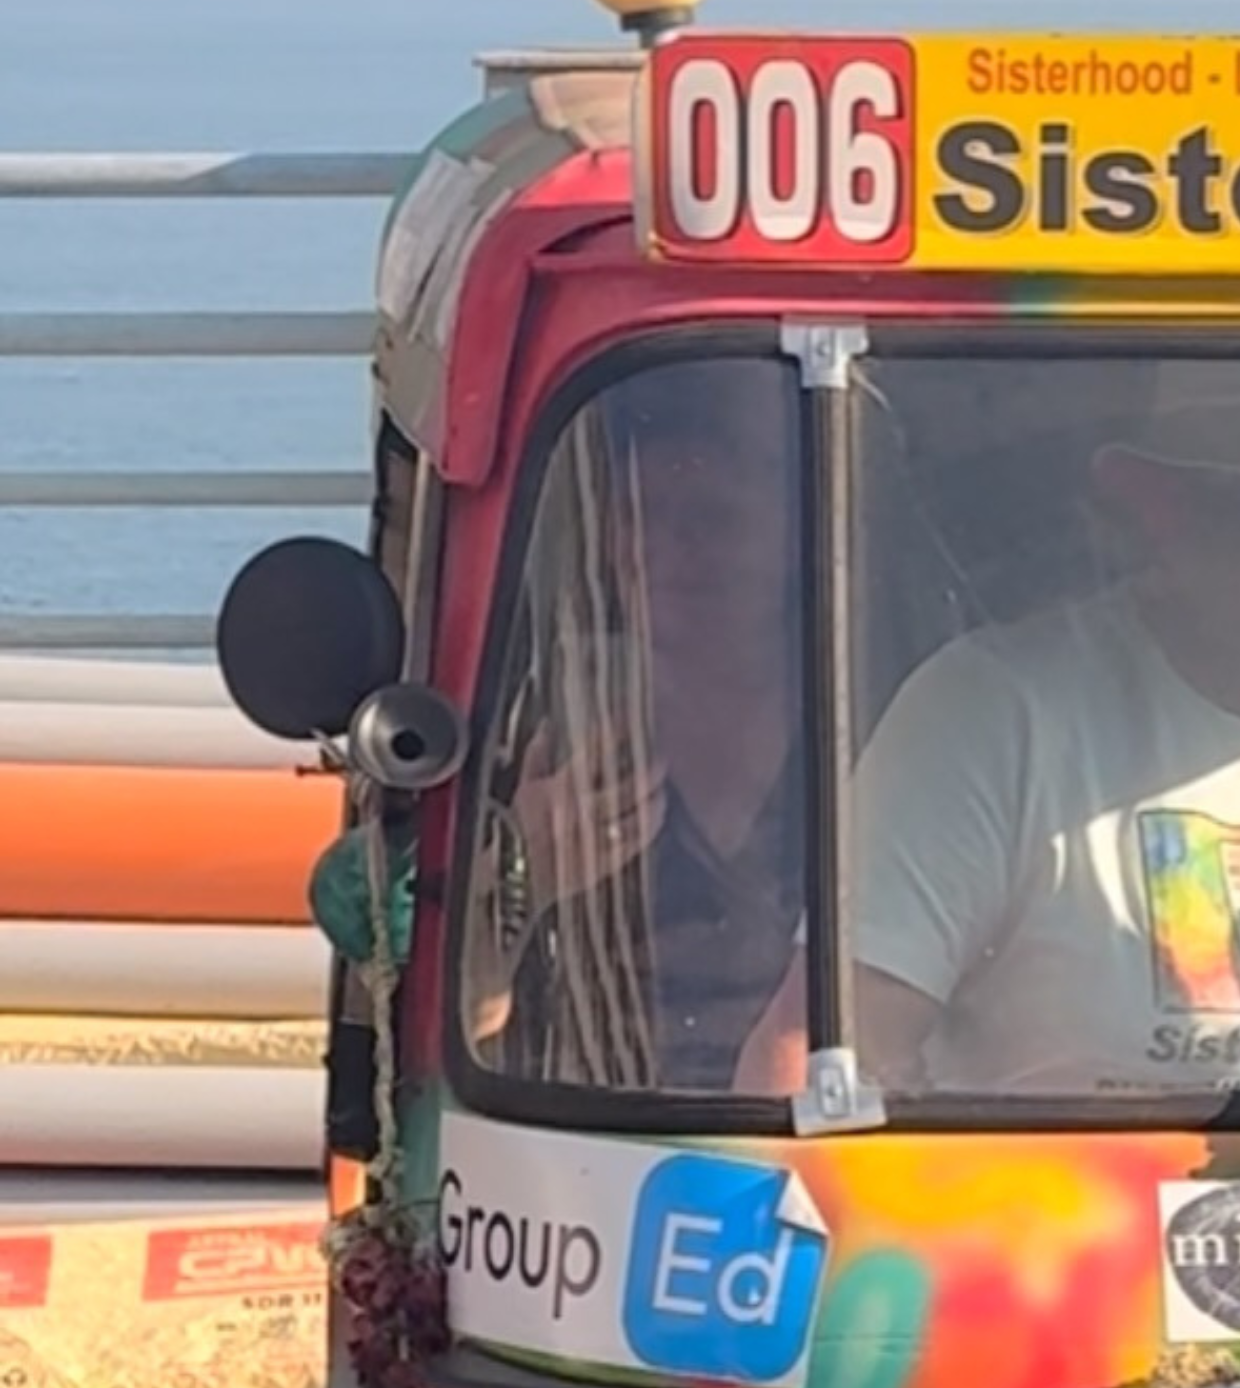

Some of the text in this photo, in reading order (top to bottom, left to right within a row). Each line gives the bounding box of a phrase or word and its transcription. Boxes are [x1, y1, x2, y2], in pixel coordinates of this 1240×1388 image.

[668, 57, 903, 242] 006
[966, 47, 1193, 95] Sisterhood
[1207, 72, 1222, 85] -
[436, 1168, 792, 1327] Group Ed
